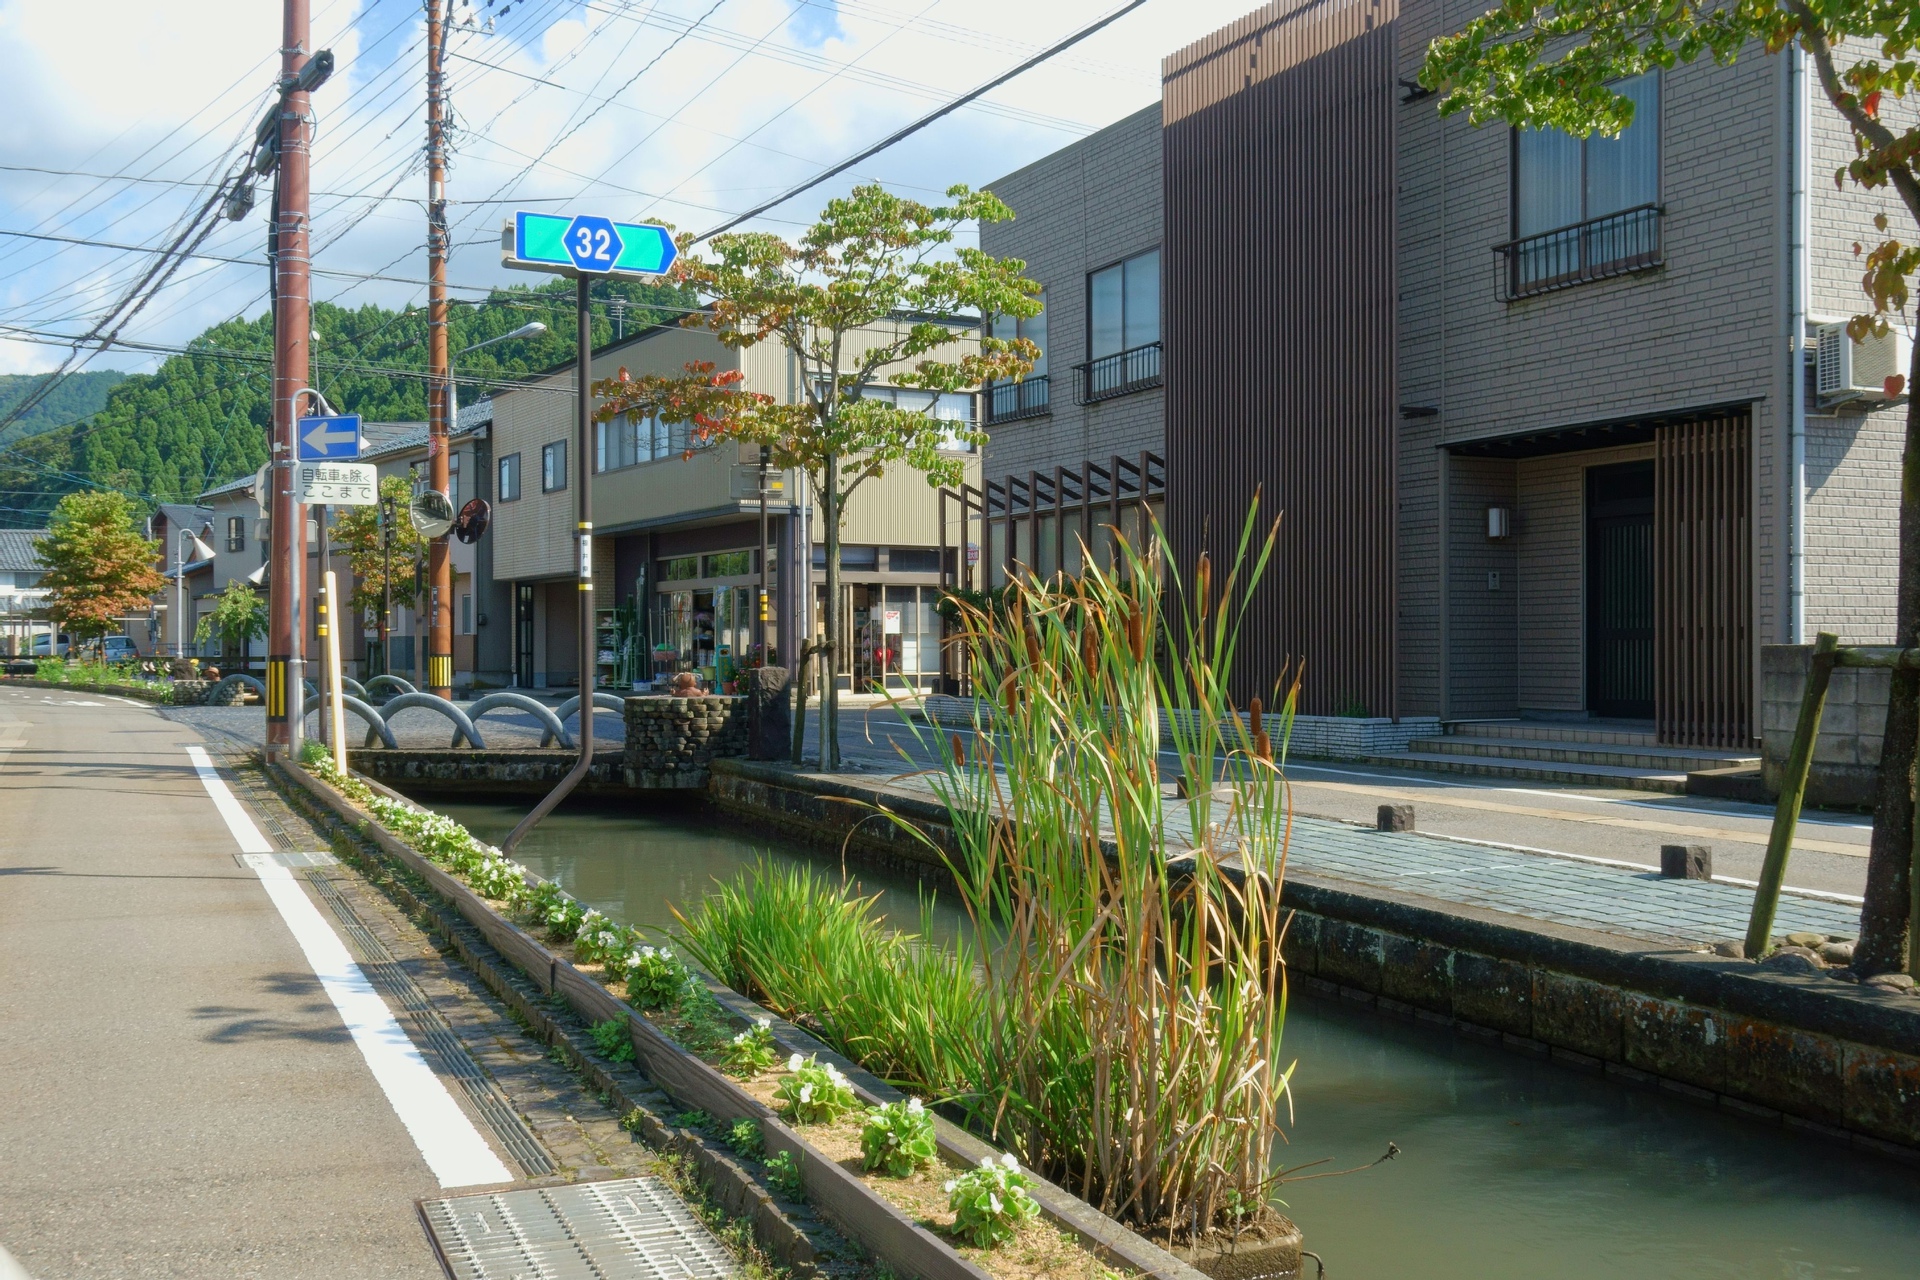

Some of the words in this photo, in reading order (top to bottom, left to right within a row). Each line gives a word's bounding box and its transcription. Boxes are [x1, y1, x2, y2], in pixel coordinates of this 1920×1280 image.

[575, 227, 611, 261] 32
[302, 468, 370, 483] 自転車を除く
[303, 485, 371, 499] ここまで
